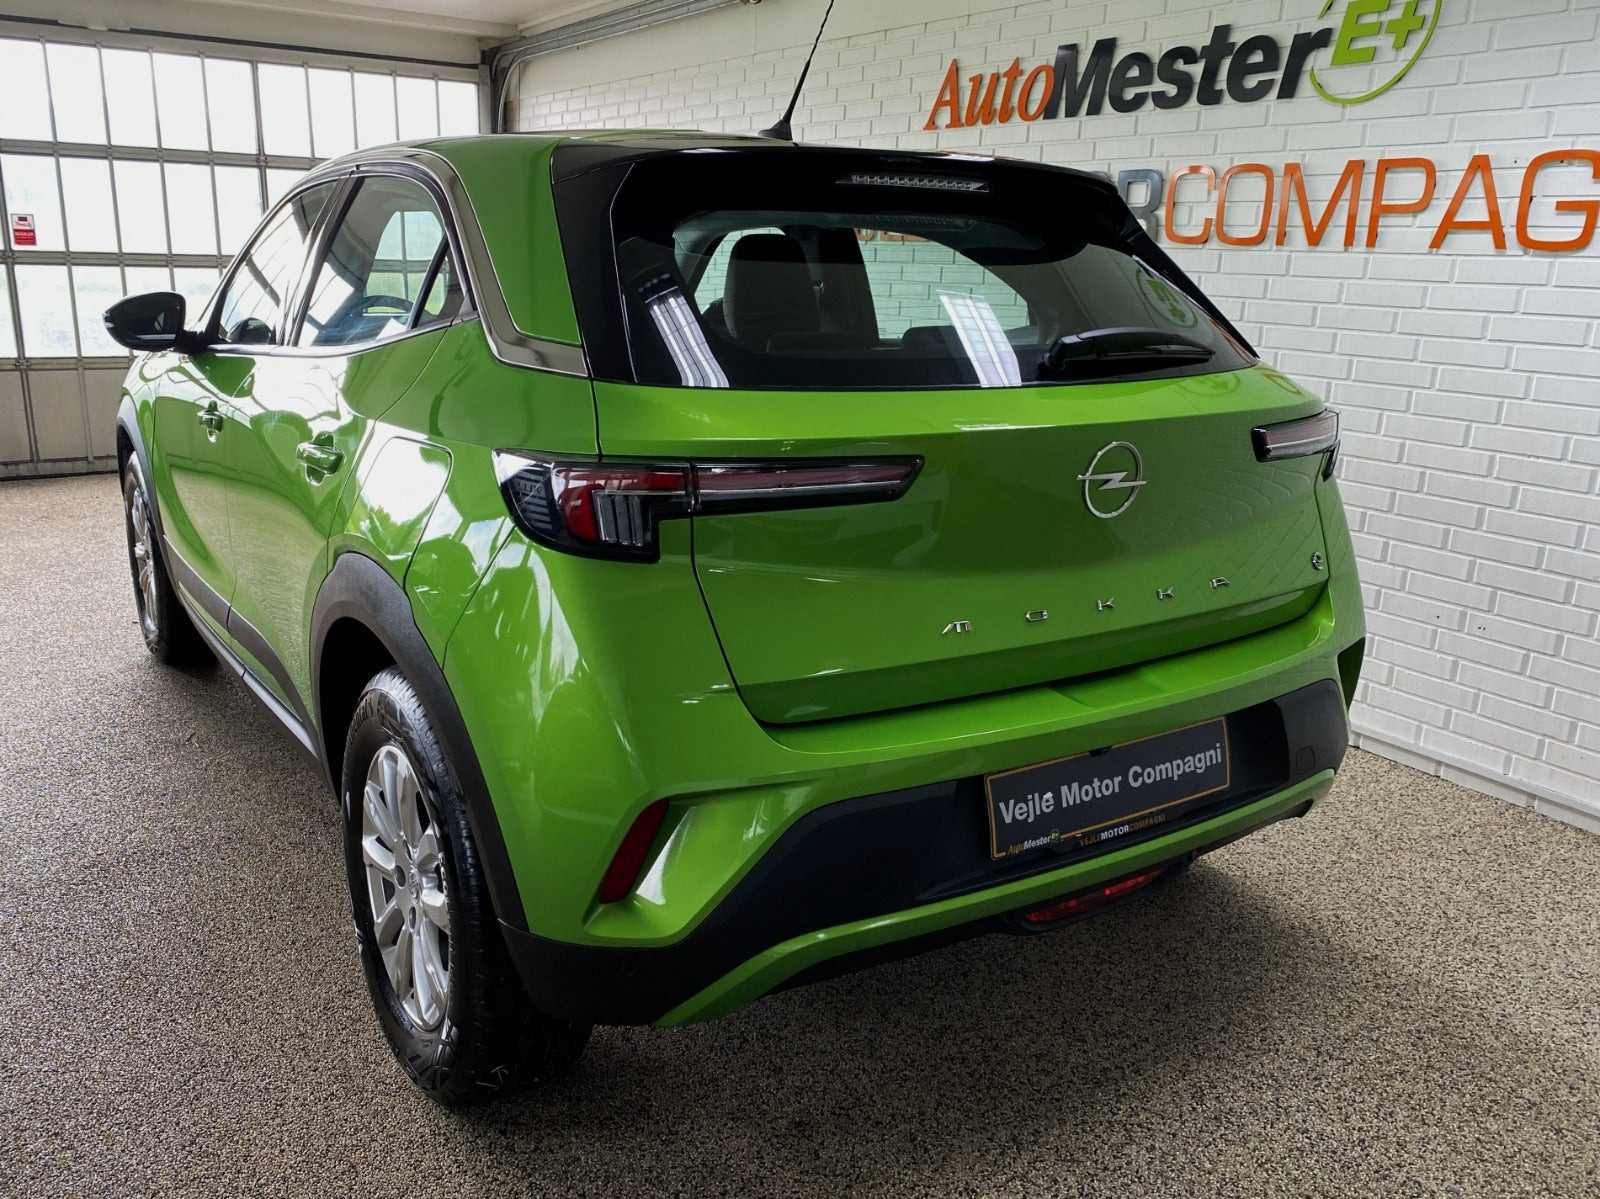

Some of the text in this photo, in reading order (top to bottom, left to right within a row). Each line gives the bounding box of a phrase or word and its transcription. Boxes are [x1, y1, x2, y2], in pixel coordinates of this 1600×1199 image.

[923, 24, 1333, 131] AutoMester
[1094, 148, 1600, 252] RCOMPAG
[998, 742, 1222, 824] Vejle Motor Compagni
